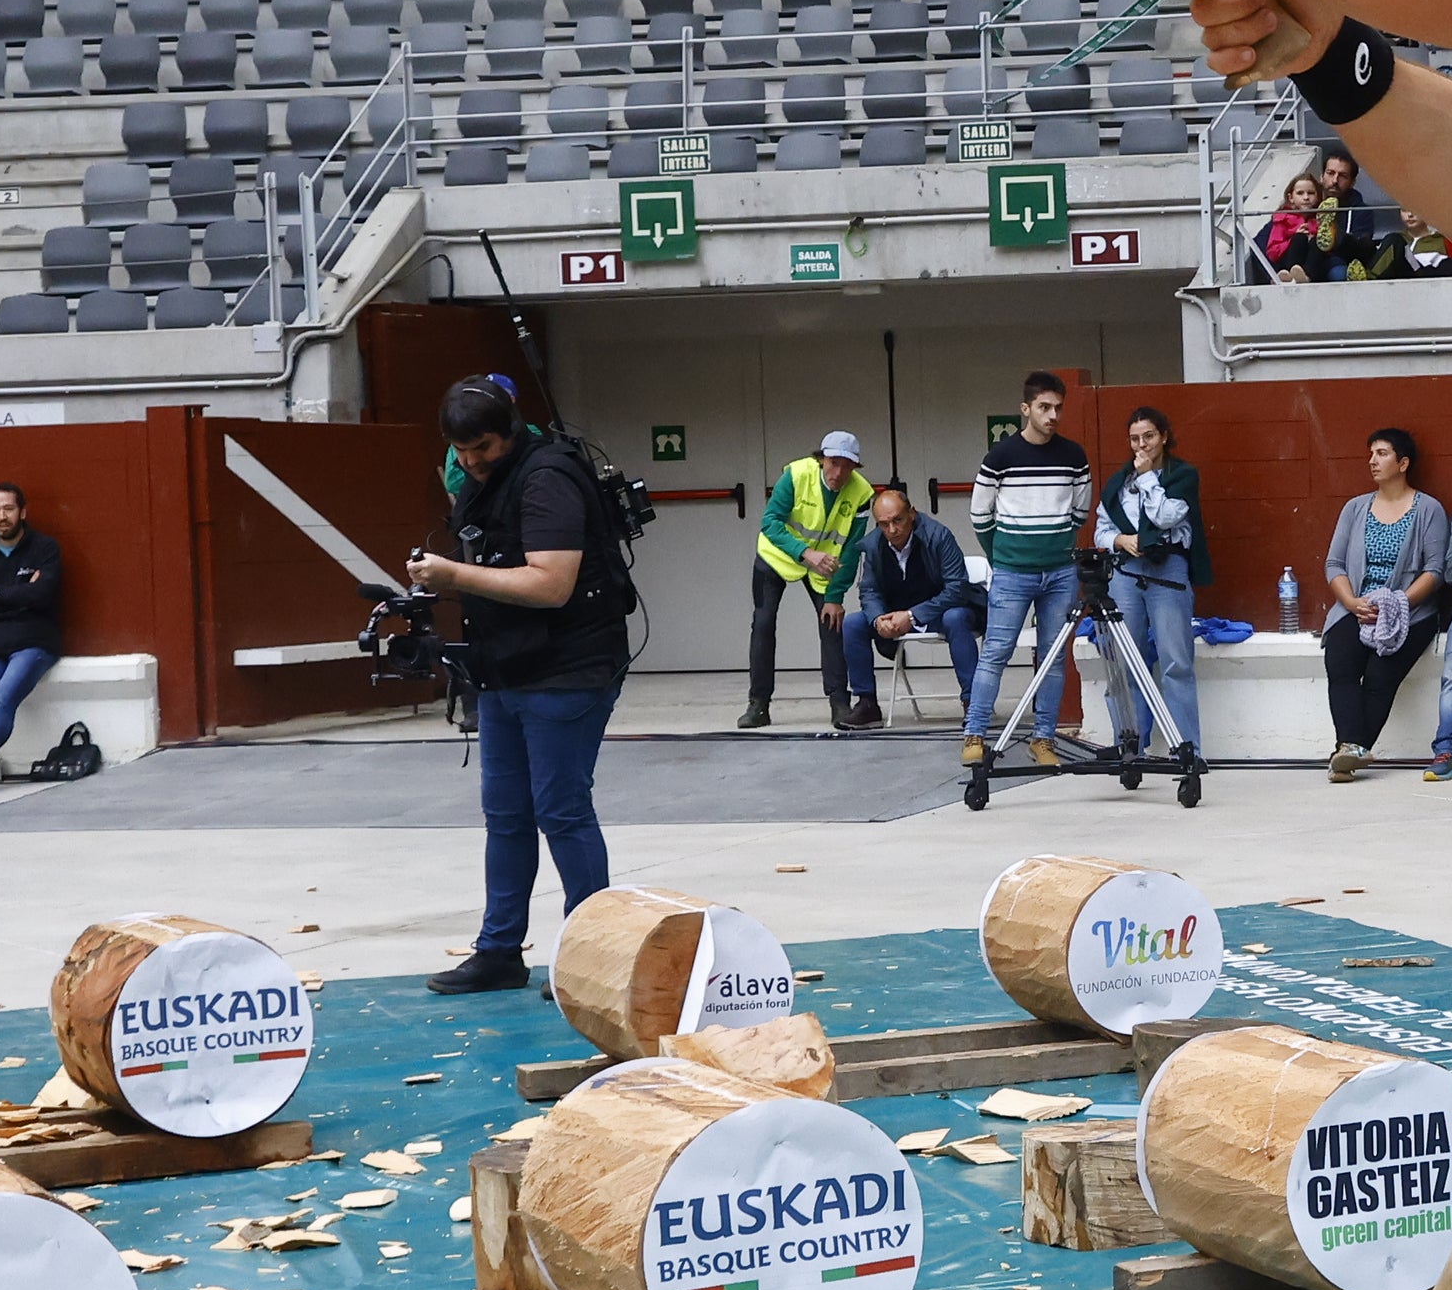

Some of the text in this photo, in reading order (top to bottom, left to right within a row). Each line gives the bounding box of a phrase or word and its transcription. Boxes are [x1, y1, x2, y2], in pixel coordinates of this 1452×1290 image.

[663, 137, 706, 152] SALIDA
[963, 124, 1007, 139] SALIDA
[663, 155, 706, 172] IRTEERA
[963, 142, 1007, 158] IRTEERA
[797, 250, 832, 262] SALIDA
[1081, 235, 1131, 262] P1
[570, 255, 617, 280] P1
[795, 262, 836, 274] IRTEERA
[1090, 913, 1198, 972] Vital
[718, 968, 791, 1000] álava
[1076, 968, 1219, 996] FUNDACIÓN FUNDAZIOA
[118, 985, 301, 1038] EUSKADI
[704, 995, 791, 1015] diputación foral
[121, 1025, 305, 1063] BASQUE COUNTRY
[1307, 1111, 1451, 1167] VITORIA
[1307, 1159, 1452, 1220] GASTEIZ
[653, 1169, 907, 1248] EUSKADI
[1321, 1204, 1452, 1254] green capital
[656, 1222, 912, 1286] BASQUE COUNTRY
